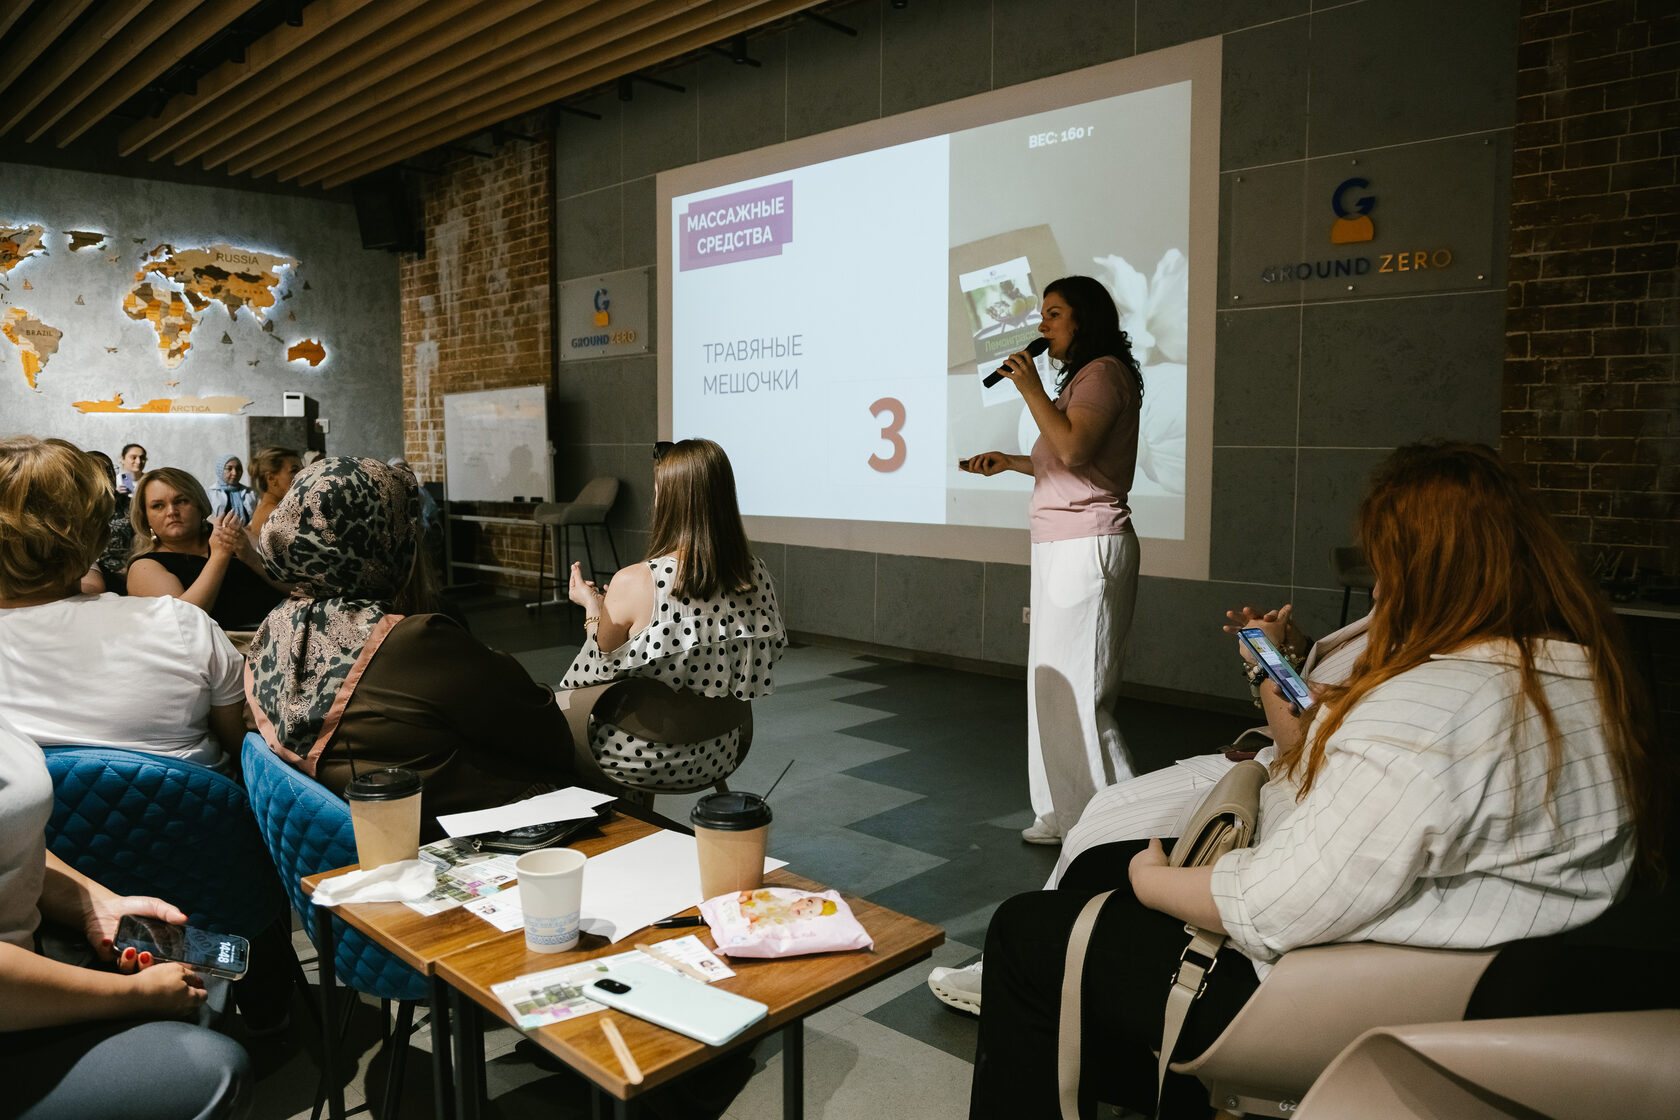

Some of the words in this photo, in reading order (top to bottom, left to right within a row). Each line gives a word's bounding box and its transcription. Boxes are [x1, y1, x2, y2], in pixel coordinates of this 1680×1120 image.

[1028, 132, 1058, 149] ВЕС:
[1061, 127, 1085, 142] 160
[687, 196, 785, 232] МАССАЖНЫЕ
[696, 225, 773, 255] СРЕДСТВА
[216, 252, 259, 265] RUSSIA
[1261, 257, 1371, 283] GROUND
[1378, 249, 1452, 273] ZERO
[25, 329, 54, 337] BRAZIL
[571, 334, 610, 349] GROUND
[610, 330, 637, 345] ZERO
[702, 334, 804, 364] ТРАВЯНЫЕ
[703, 368, 799, 396] МЕШОЧКИ
[867, 397, 908, 474] 3
[218, 942, 231, 963] 14:48
